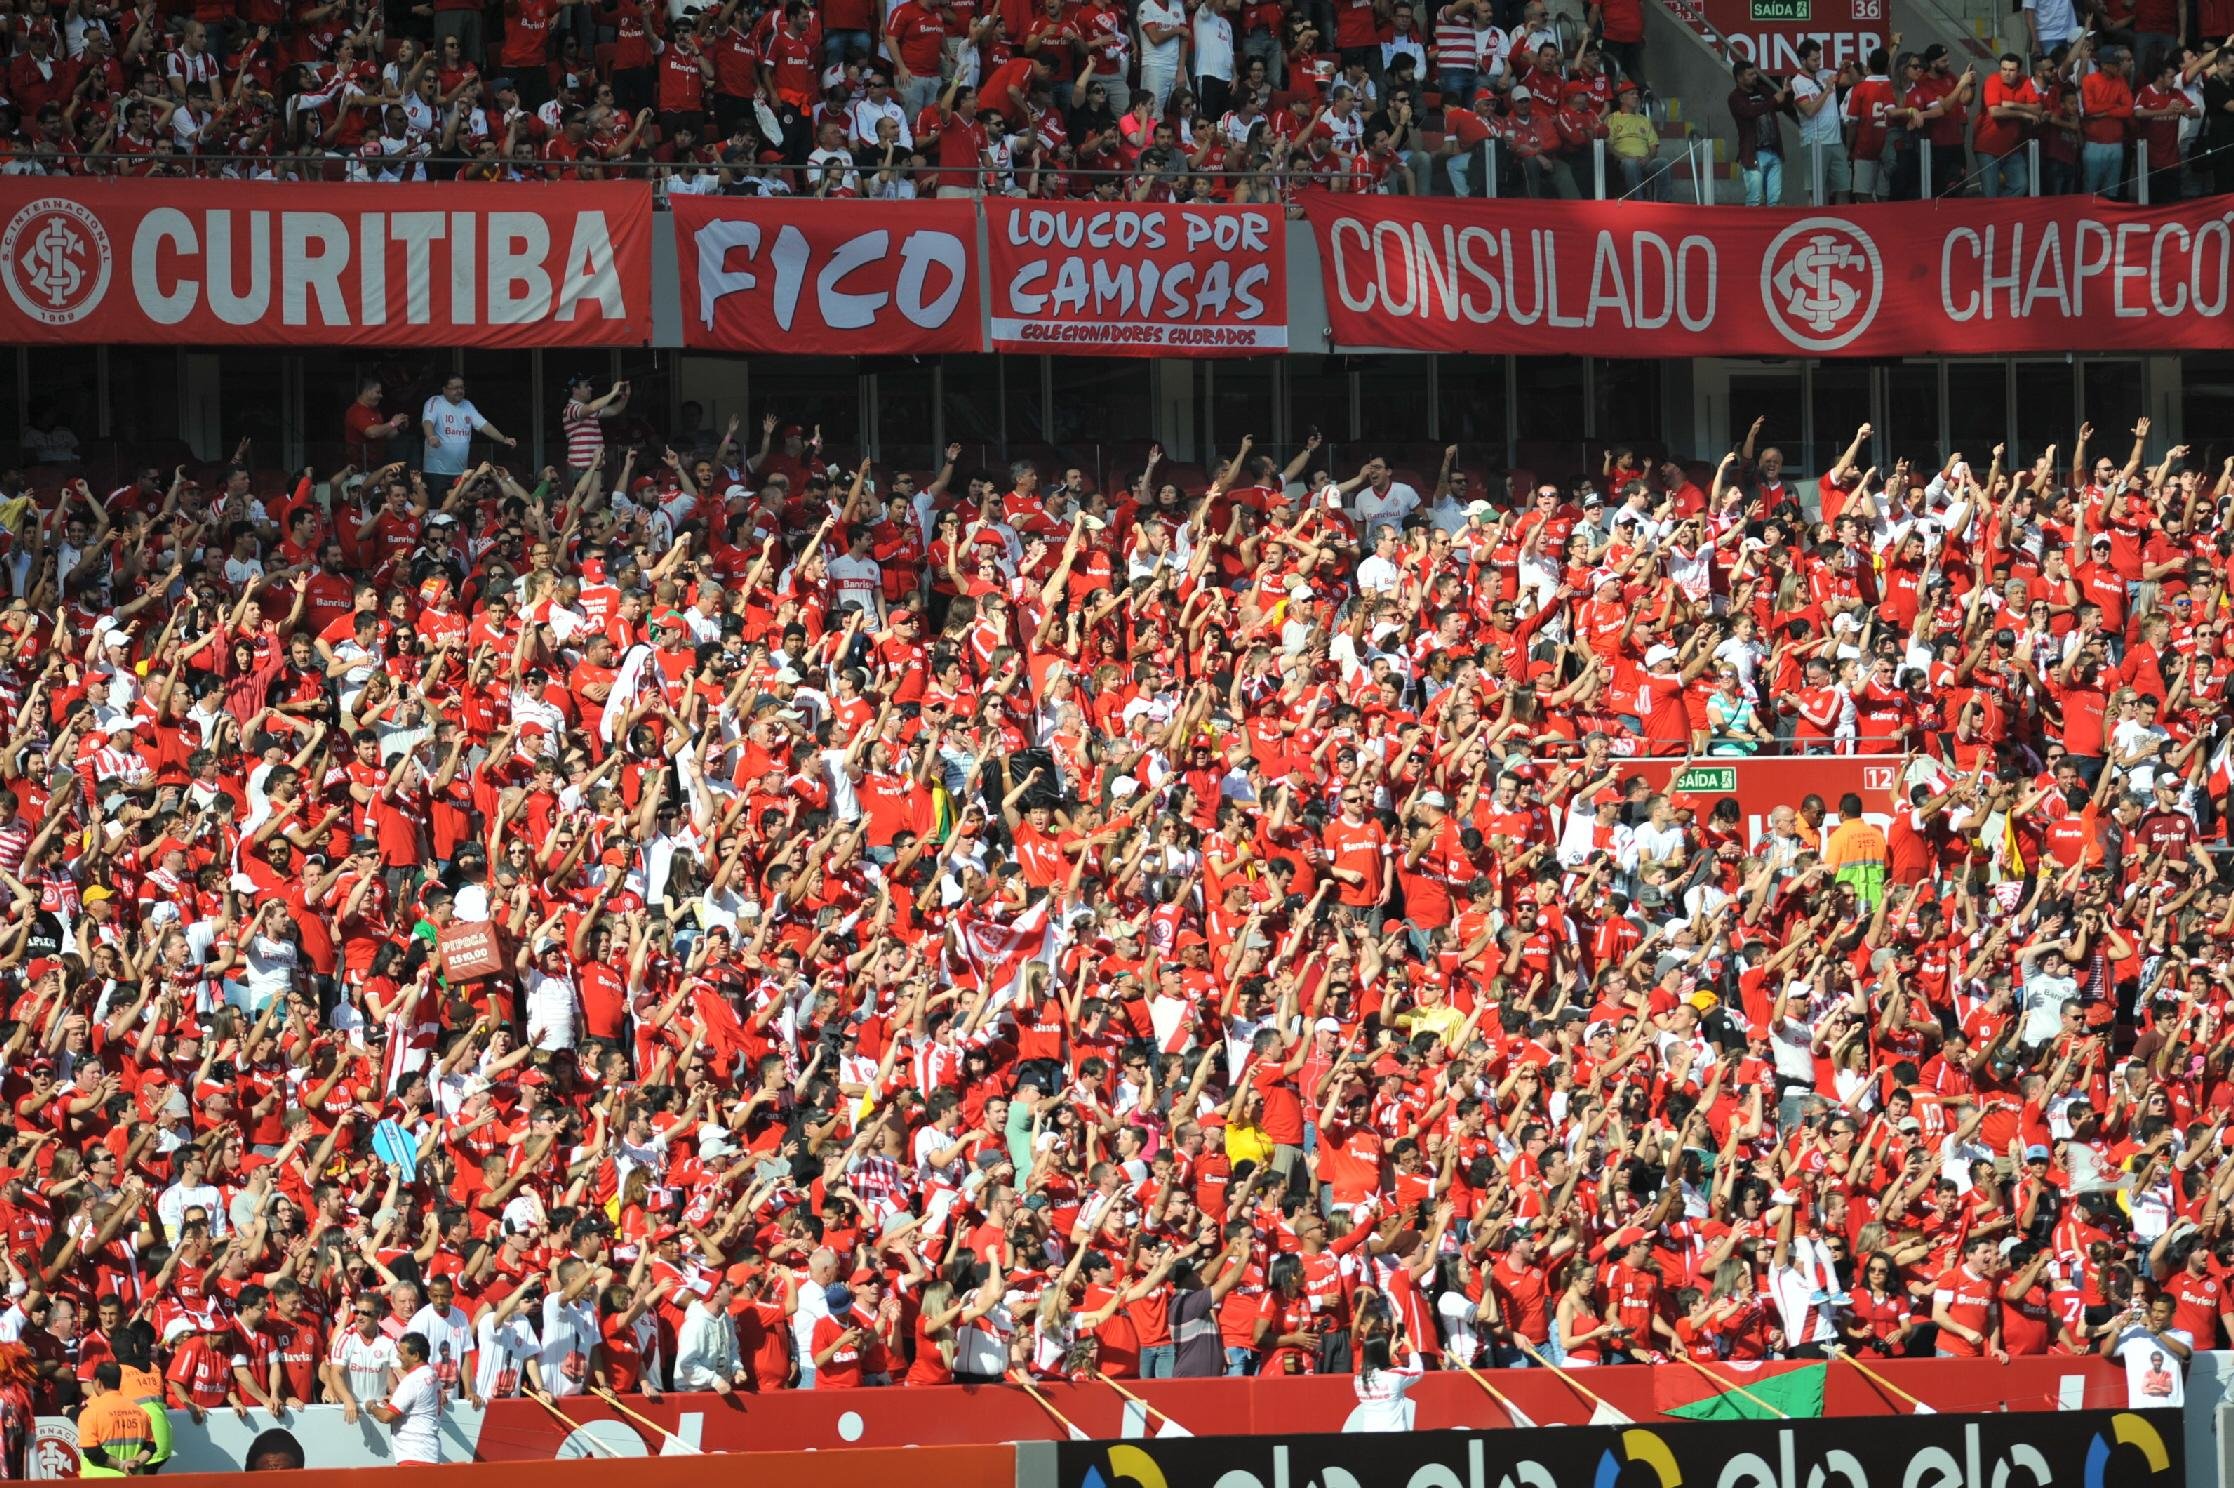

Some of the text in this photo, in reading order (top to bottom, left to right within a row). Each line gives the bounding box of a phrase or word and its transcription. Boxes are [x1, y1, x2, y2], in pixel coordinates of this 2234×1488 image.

[1754, 2, 1793, 16] SAÍDA
[1855, 1, 1879, 17] 36
[1008, 207, 1270, 253] LOUCOS POR
[131, 207, 626, 325] CURITIBA
[694, 217, 967, 332] FICO
[1009, 255, 1271, 321] CAMISAS
[1331, 216, 1717, 332] CONSULADO
[1677, 770, 1718, 788] SAÍDA
[1868, 769, 1892, 788] 12
